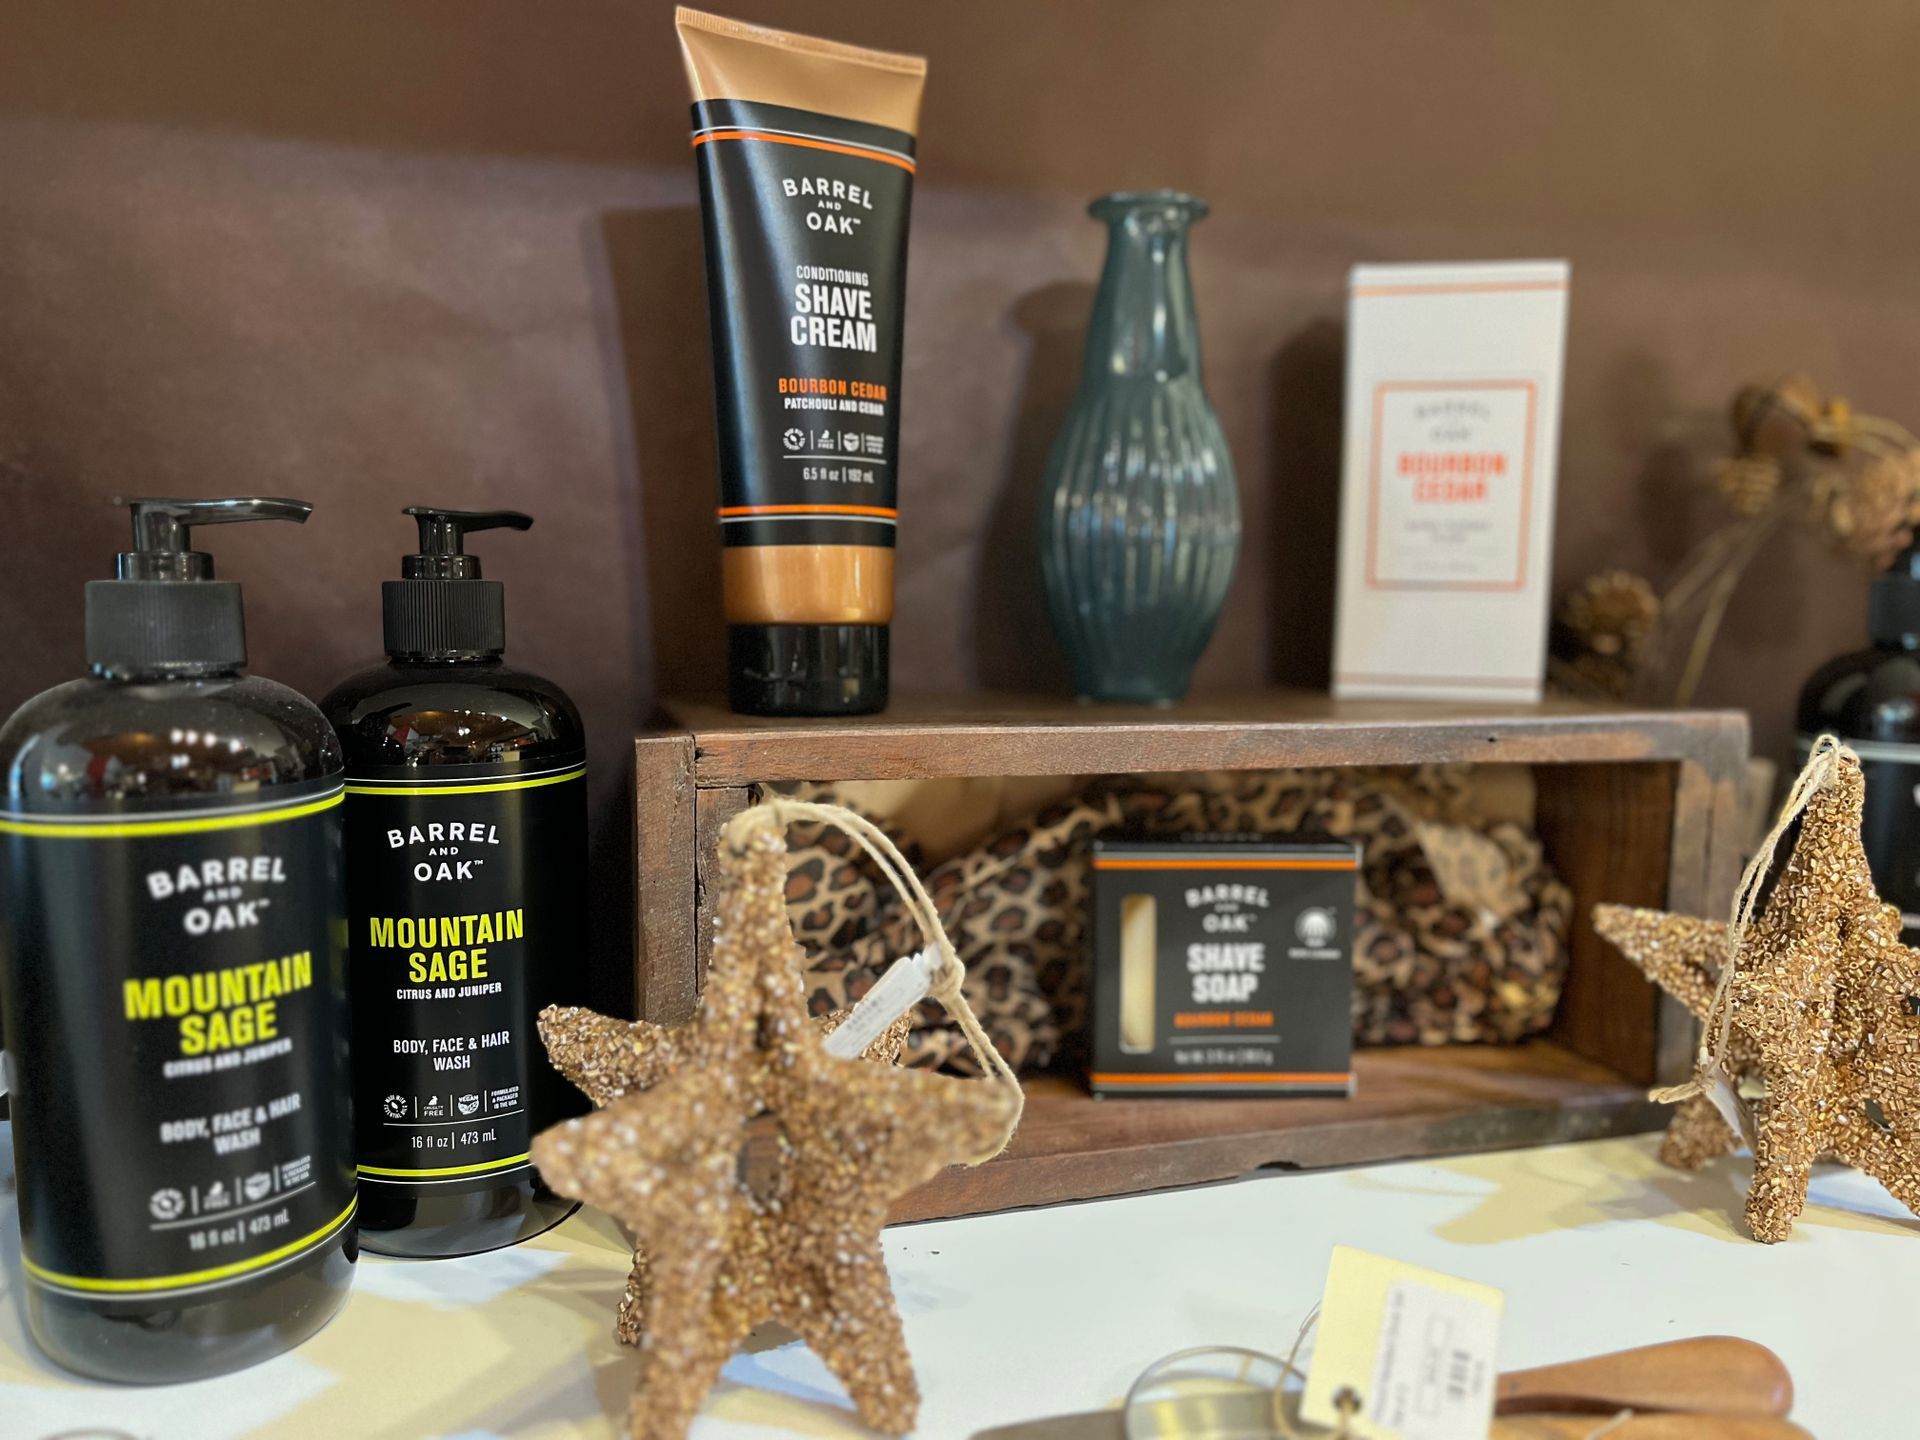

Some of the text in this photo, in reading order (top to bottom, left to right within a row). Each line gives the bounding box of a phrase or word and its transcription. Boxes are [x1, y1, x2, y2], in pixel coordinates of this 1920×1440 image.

[782, 176, 873, 210] BARREL
[817, 200, 842, 211] AND
[796, 265, 869, 287] CONDITIONING
[795, 283, 873, 320] SHAVE
[790, 315, 877, 353] CREAM
[778, 378, 887, 401] BOURBON CEDAR
[784, 397, 837, 411] PATCHOULI
[839, 400, 858, 413] AND
[803, 467, 818, 480] 6.5
[387, 822, 500, 848] BARREL
[429, 846, 459, 856] AND
[147, 856, 286, 899] BARREL
[203, 886, 243, 902] AND
[370, 908, 523, 948] MOUNTAIN
[409, 948, 488, 983] SAGE
[1186, 943, 1266, 973] SHAVE
[123, 950, 312, 1020] MOUNTAIN
[396, 982, 502, 1000] CITRUS AND JUNIPER
[1191, 973, 1259, 1004] SOAP
[179, 1001, 278, 1056] SAGE
[393, 1030, 510, 1055] BODY, FACE & HAIR
[214, 1051, 242, 1070] AND
[433, 1055, 471, 1071] WASH
[458, 1094, 479, 1102] VEGAN
[212, 1108, 252, 1134] FACE
[269, 1092, 301, 1119] HAIR
[213, 1127, 261, 1154] WASH
[411, 1128, 496, 1148] 16 fl oz 473 mL
[250, 1214, 271, 1235] 473
[274, 1208, 290, 1227] mL
